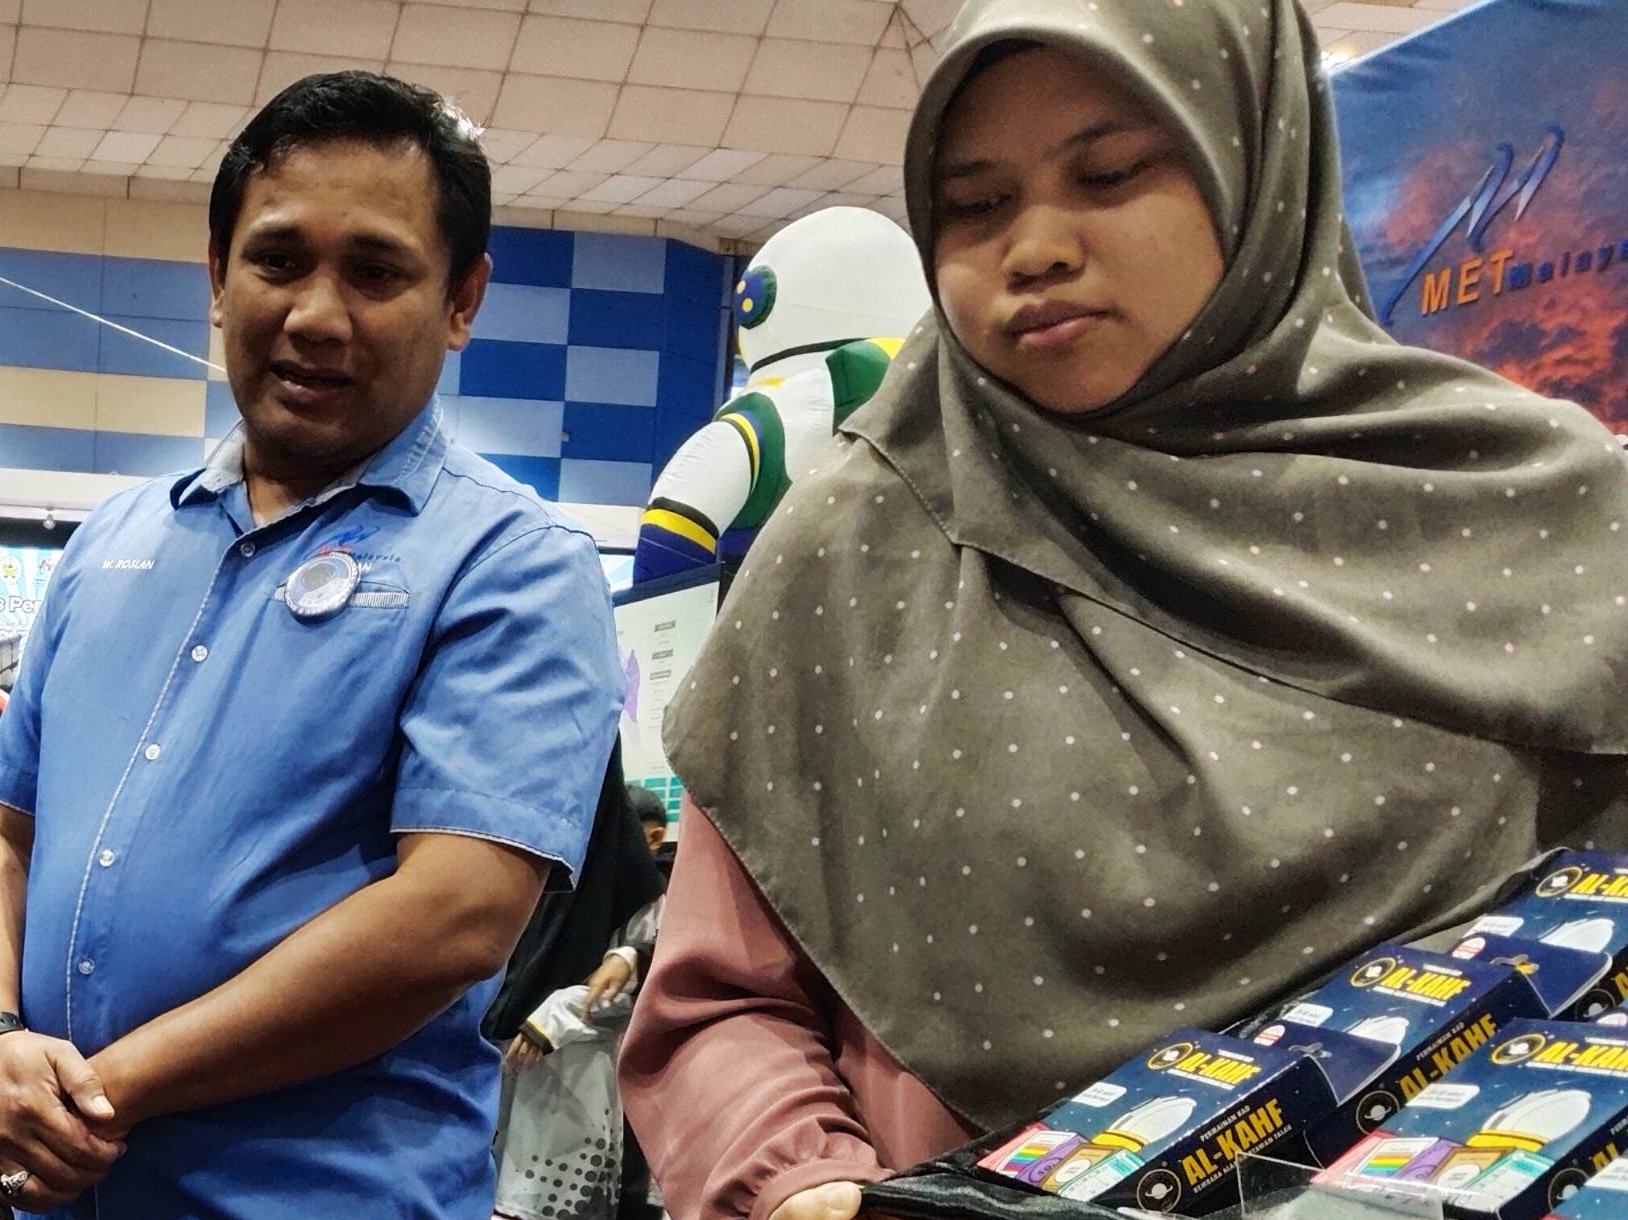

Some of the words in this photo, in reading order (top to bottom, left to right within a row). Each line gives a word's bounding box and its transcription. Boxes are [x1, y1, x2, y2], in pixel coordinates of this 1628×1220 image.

[1175, 1051, 1262, 1085] AL-KAHF
[1182, 1097, 1284, 1185] AL-KAHF
[1200, 1114, 1237, 1142] PERMAINAN
[1236, 1105, 1250, 1117] KAD
